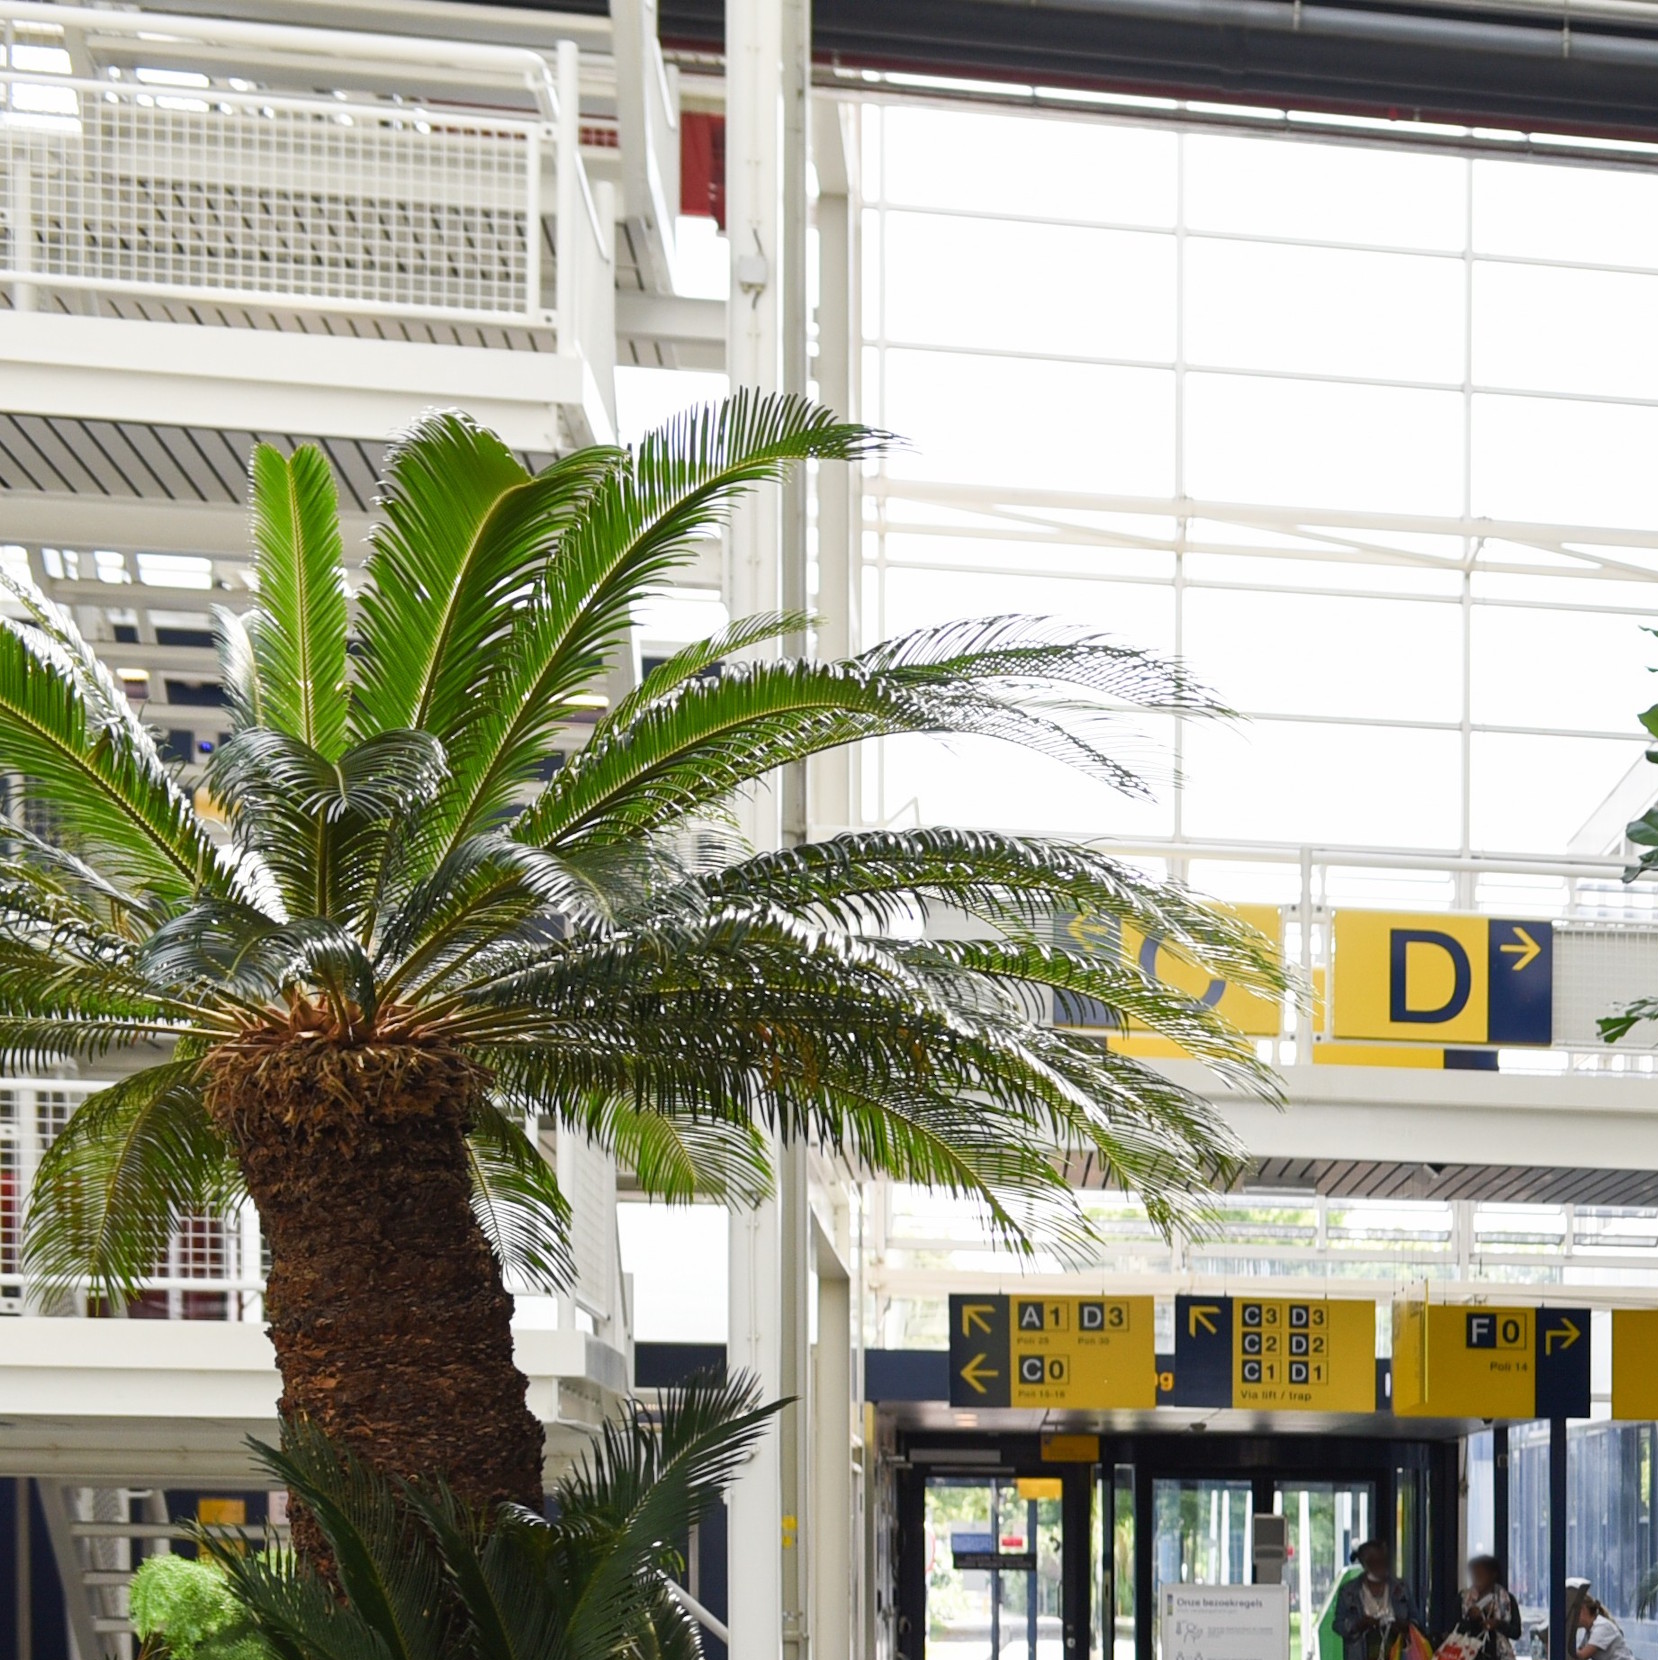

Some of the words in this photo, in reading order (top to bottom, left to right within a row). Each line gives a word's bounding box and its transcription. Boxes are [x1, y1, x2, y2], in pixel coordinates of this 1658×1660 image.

[1390, 928, 1472, 1024] D
[1490, 1361, 1511, 1372] Poli
[1514, 1362, 1528, 1373] 14
[1241, 1390, 1259, 1400] Via
[1262, 1390, 1278, 1401] lift
[1289, 1391, 1312, 1402] trap
[1176, 1597, 1201, 1608] Onze
